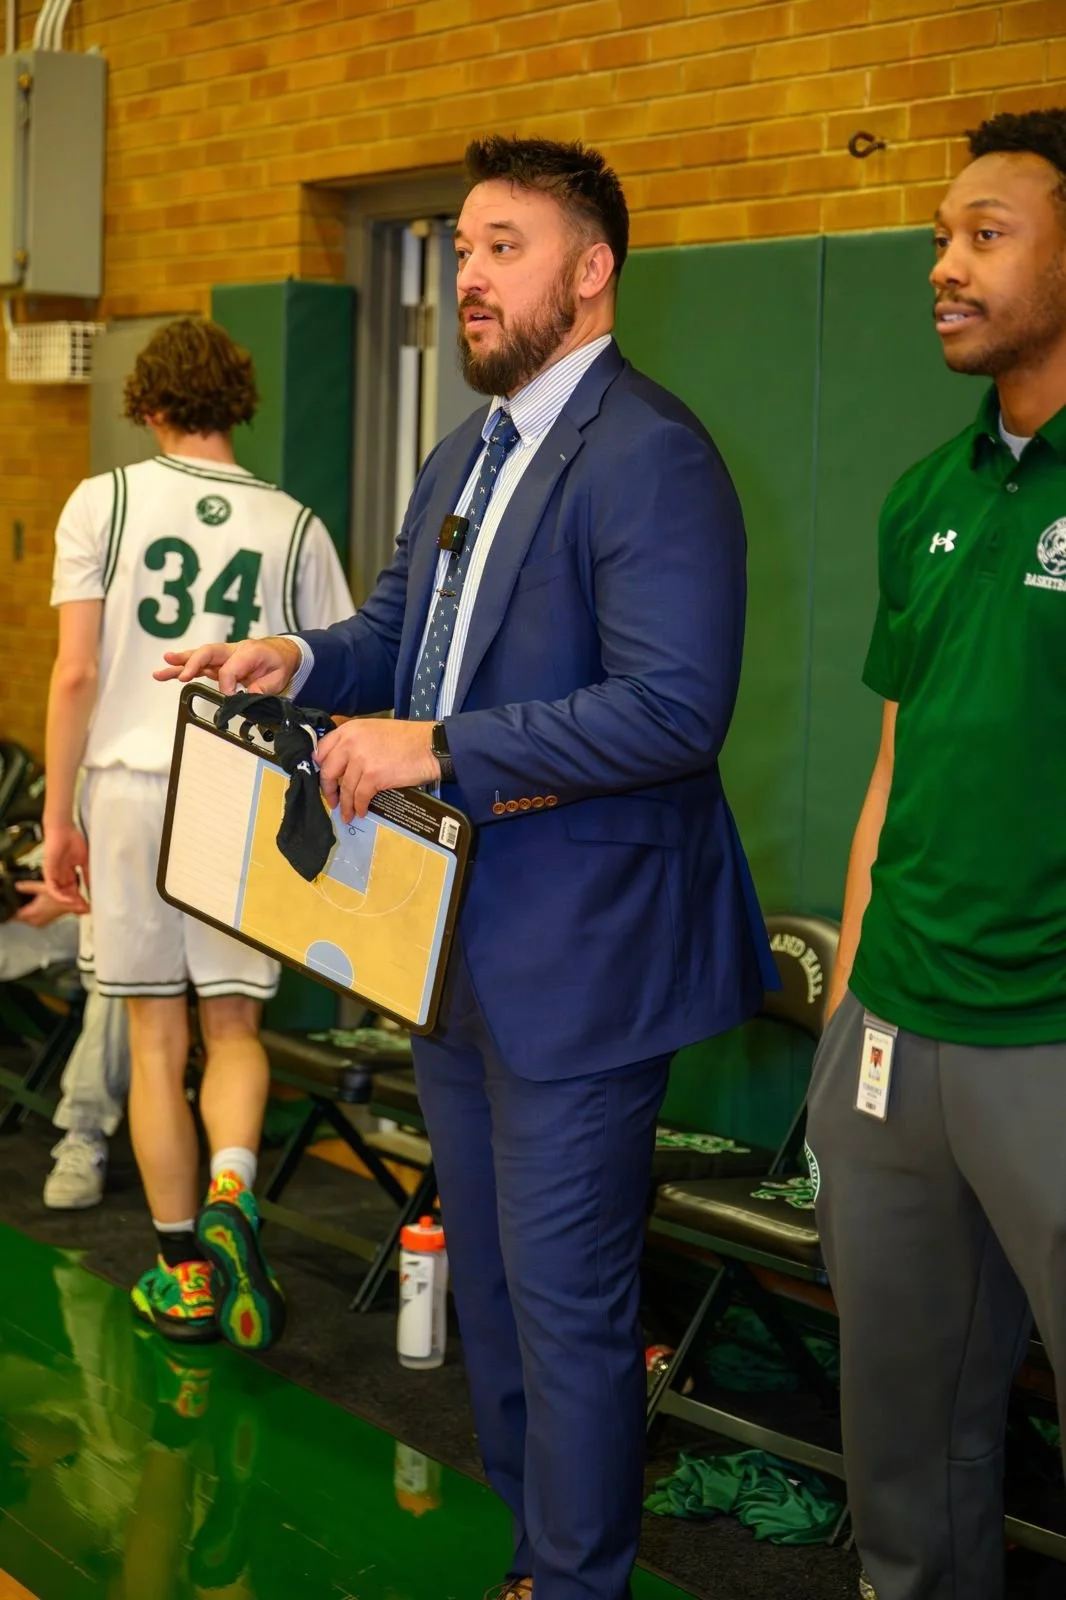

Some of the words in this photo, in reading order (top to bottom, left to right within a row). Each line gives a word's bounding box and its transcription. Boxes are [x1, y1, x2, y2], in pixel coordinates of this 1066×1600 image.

[138, 536, 262, 642] 34
[770, 933, 806, 957] AND
[799, 947, 823, 1004] HALL
